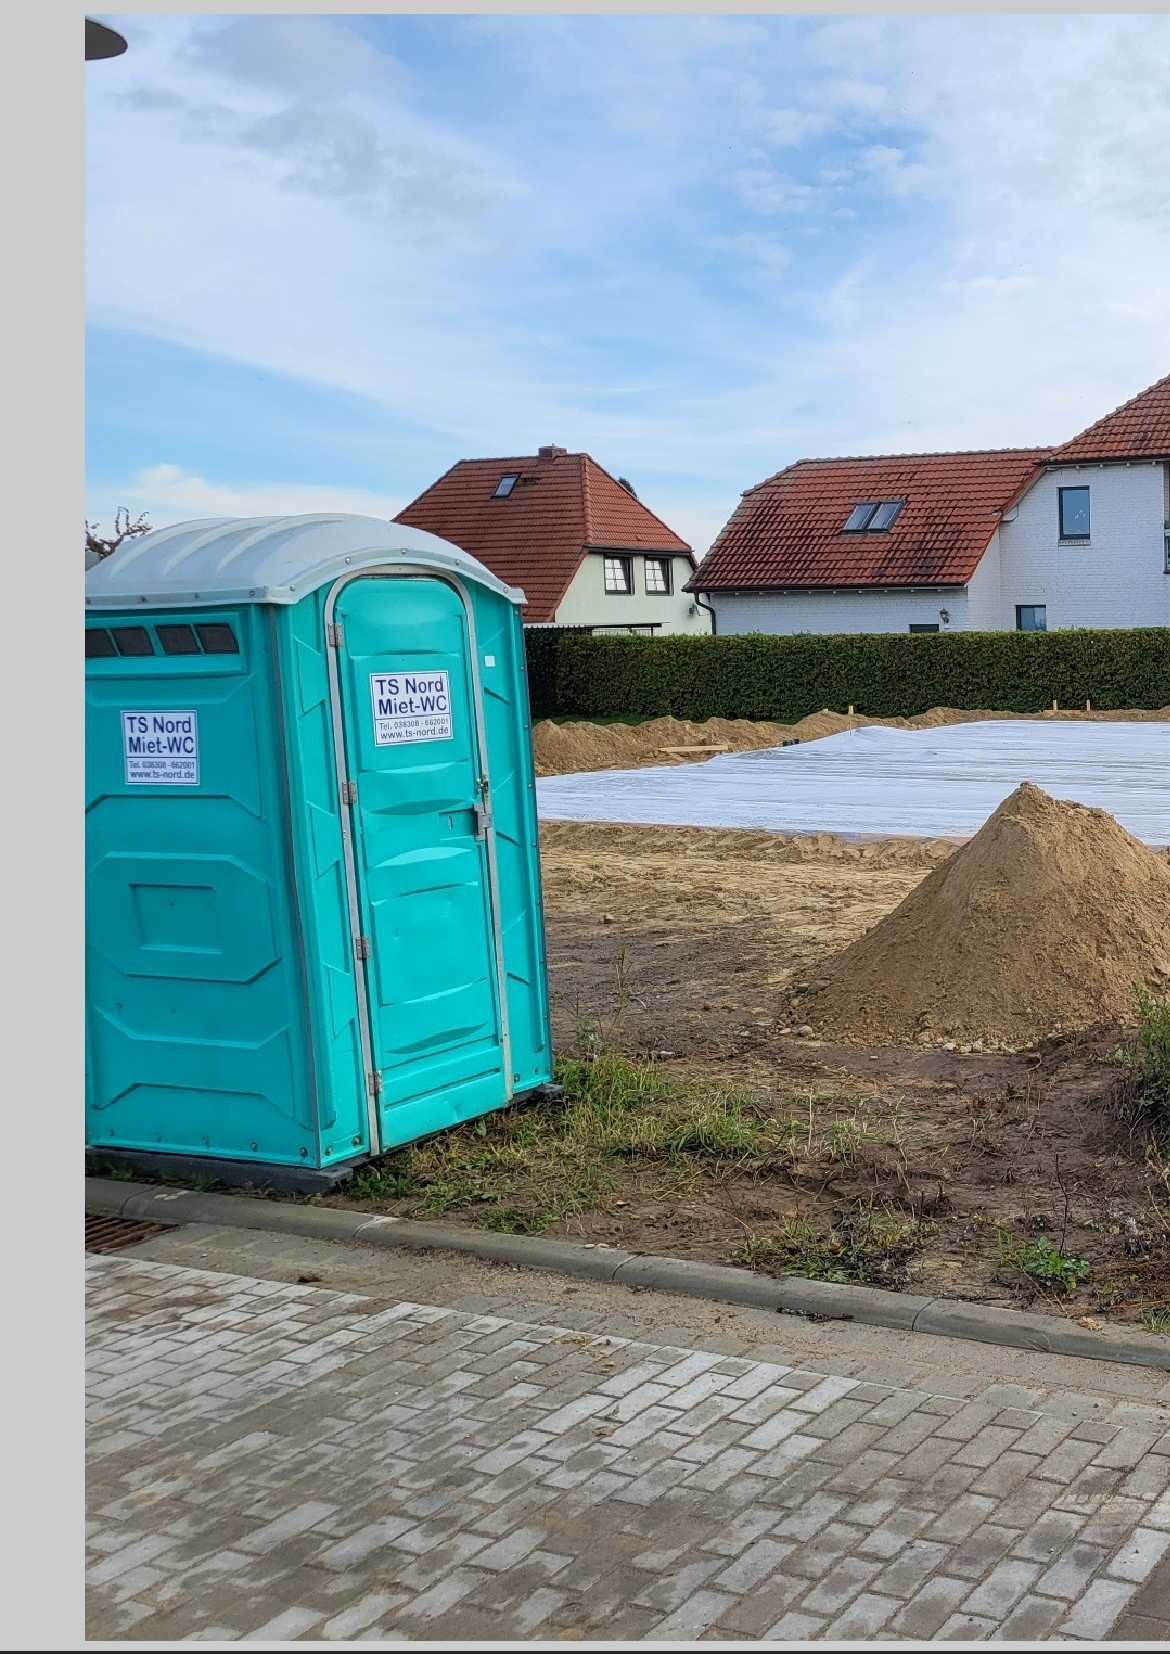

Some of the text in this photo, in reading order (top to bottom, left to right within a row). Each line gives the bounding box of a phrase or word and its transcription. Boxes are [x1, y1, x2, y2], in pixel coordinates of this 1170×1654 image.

[375, 675, 444, 696] TS Nord
[378, 695, 447, 715] Miet-WC
[126, 716, 192, 733] TS Nord
[381, 726, 449, 739] www.ts-nord.de
[128, 736, 194, 753] Miet-WC
